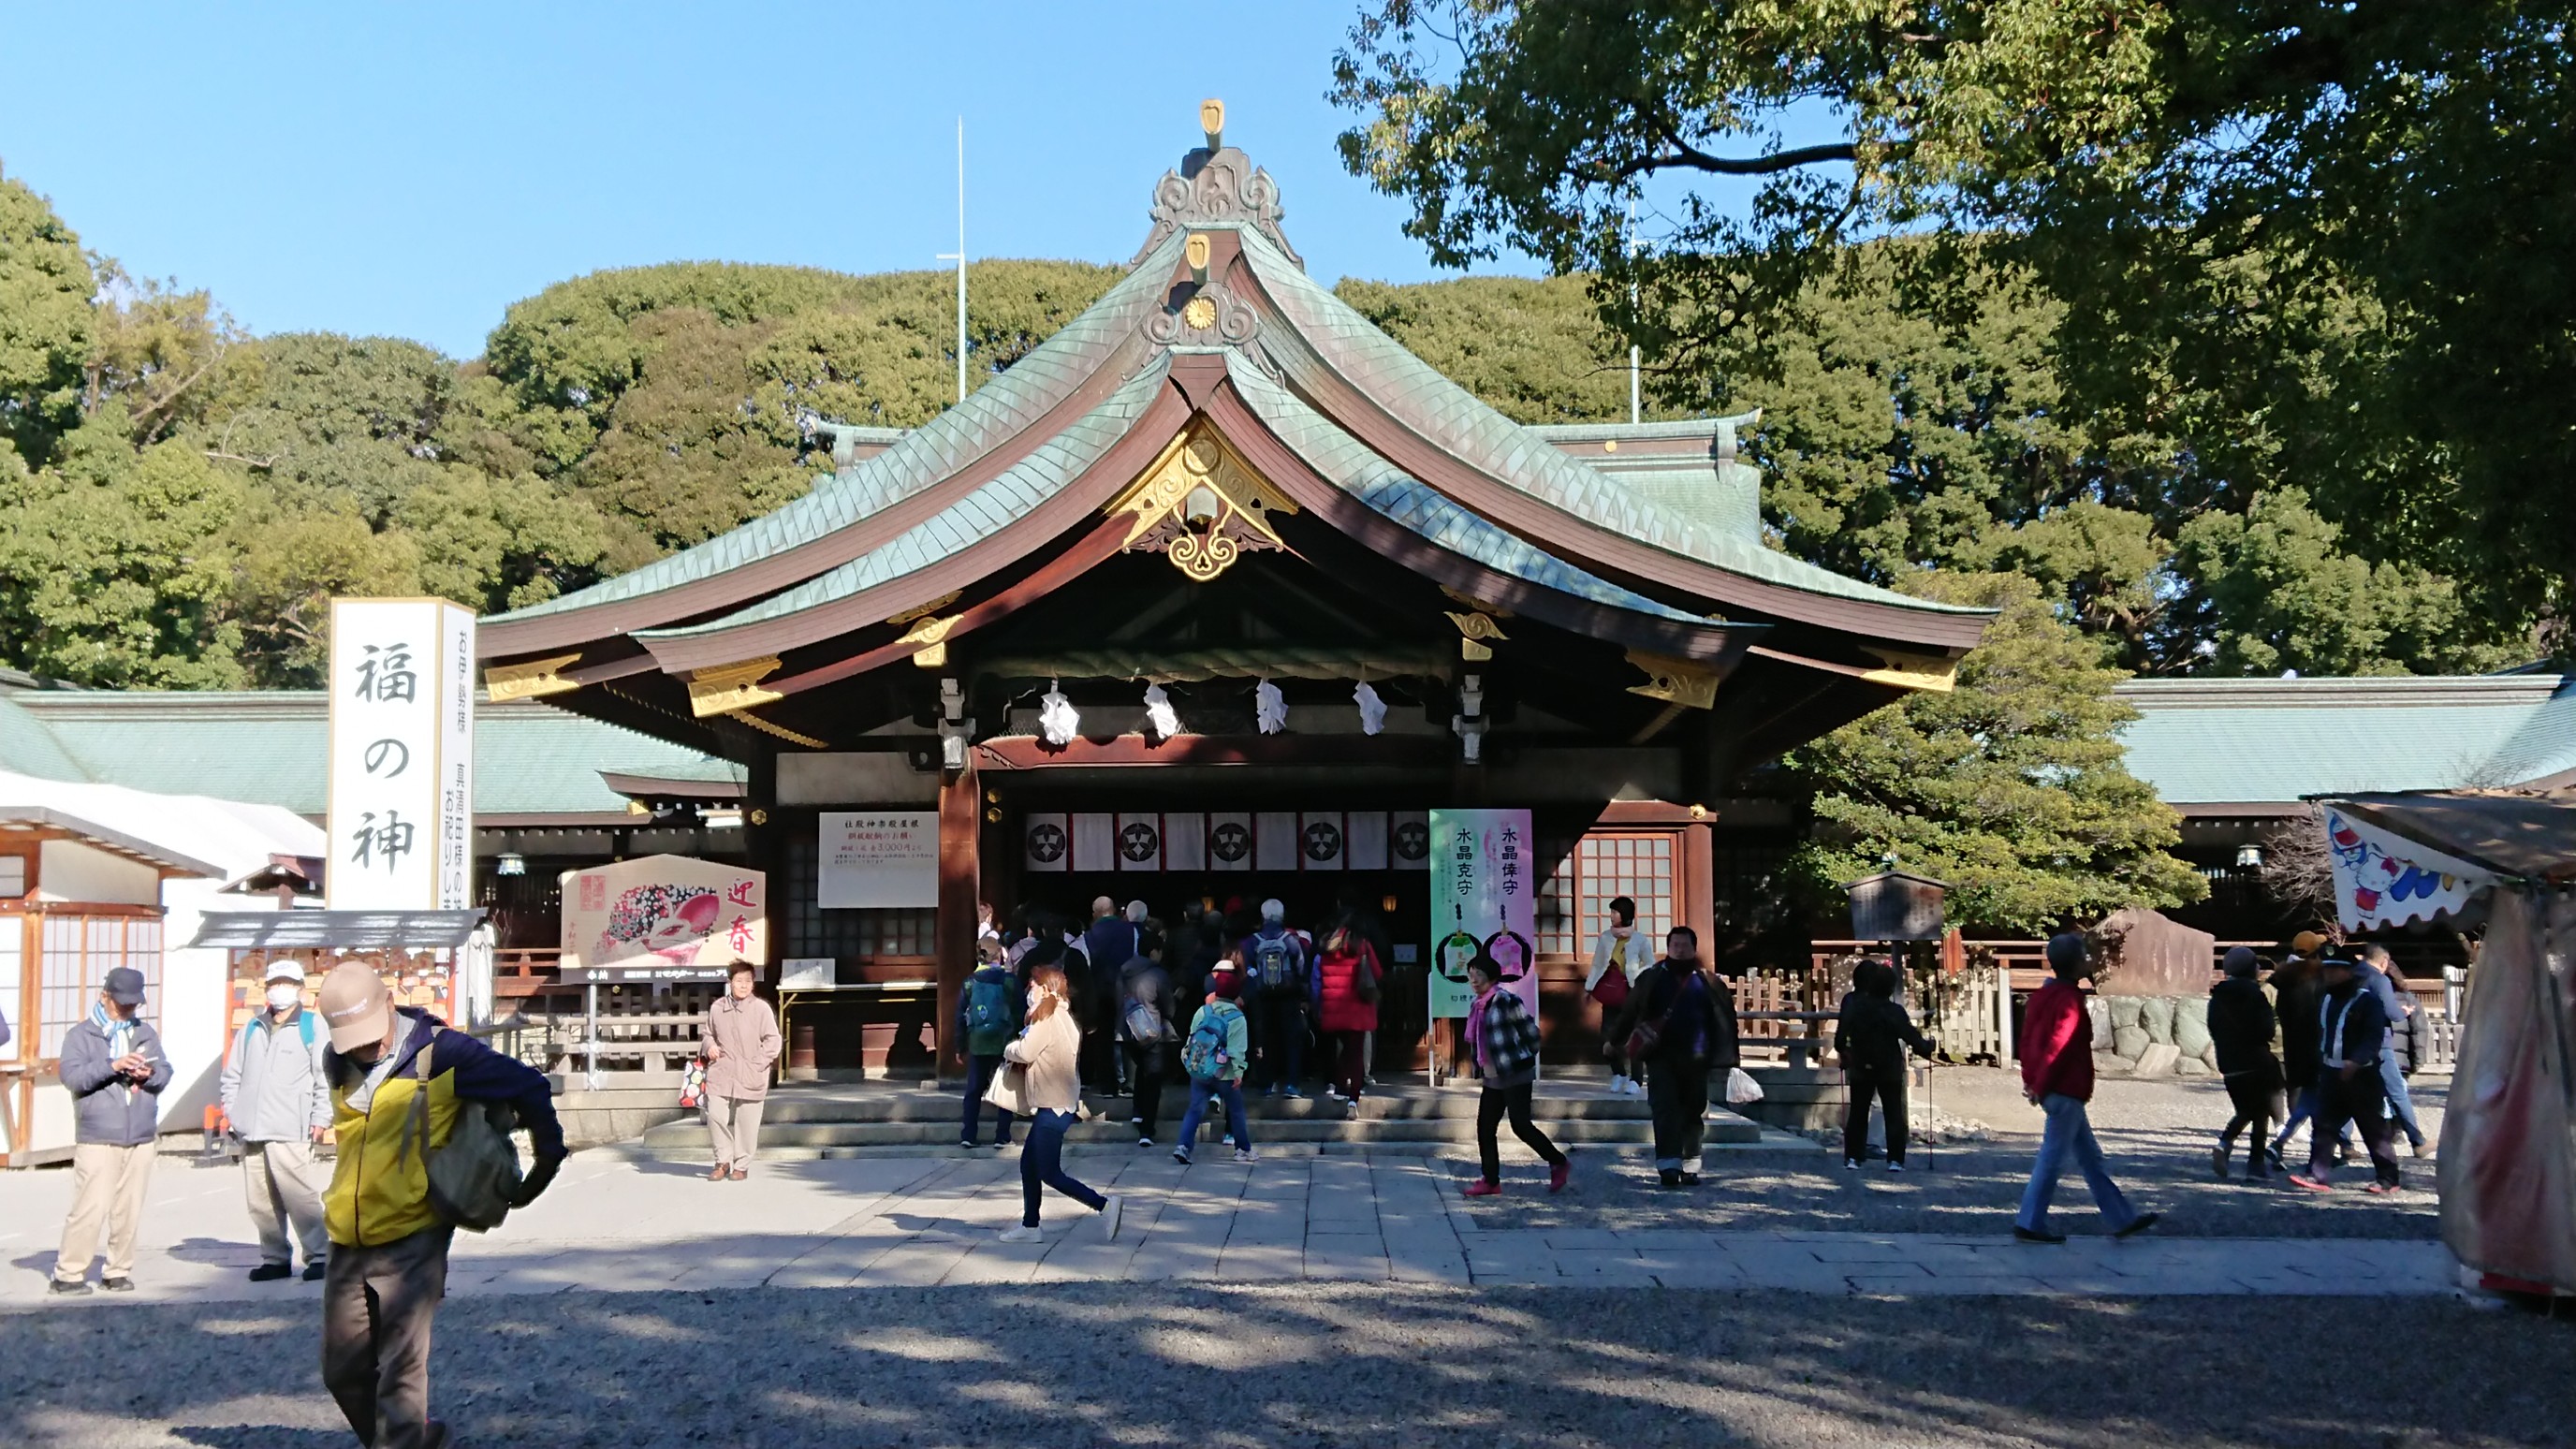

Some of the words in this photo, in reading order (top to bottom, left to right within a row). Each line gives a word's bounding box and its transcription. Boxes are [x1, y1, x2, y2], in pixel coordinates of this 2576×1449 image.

[458, 630, 467, 734] お伊勢様
[351, 642, 417, 876] 福の神
[1456, 828, 1473, 895] 水晶克守
[1501, 828, 1518, 895] 水晶倖守
[726, 878, 757, 954] 迎春
